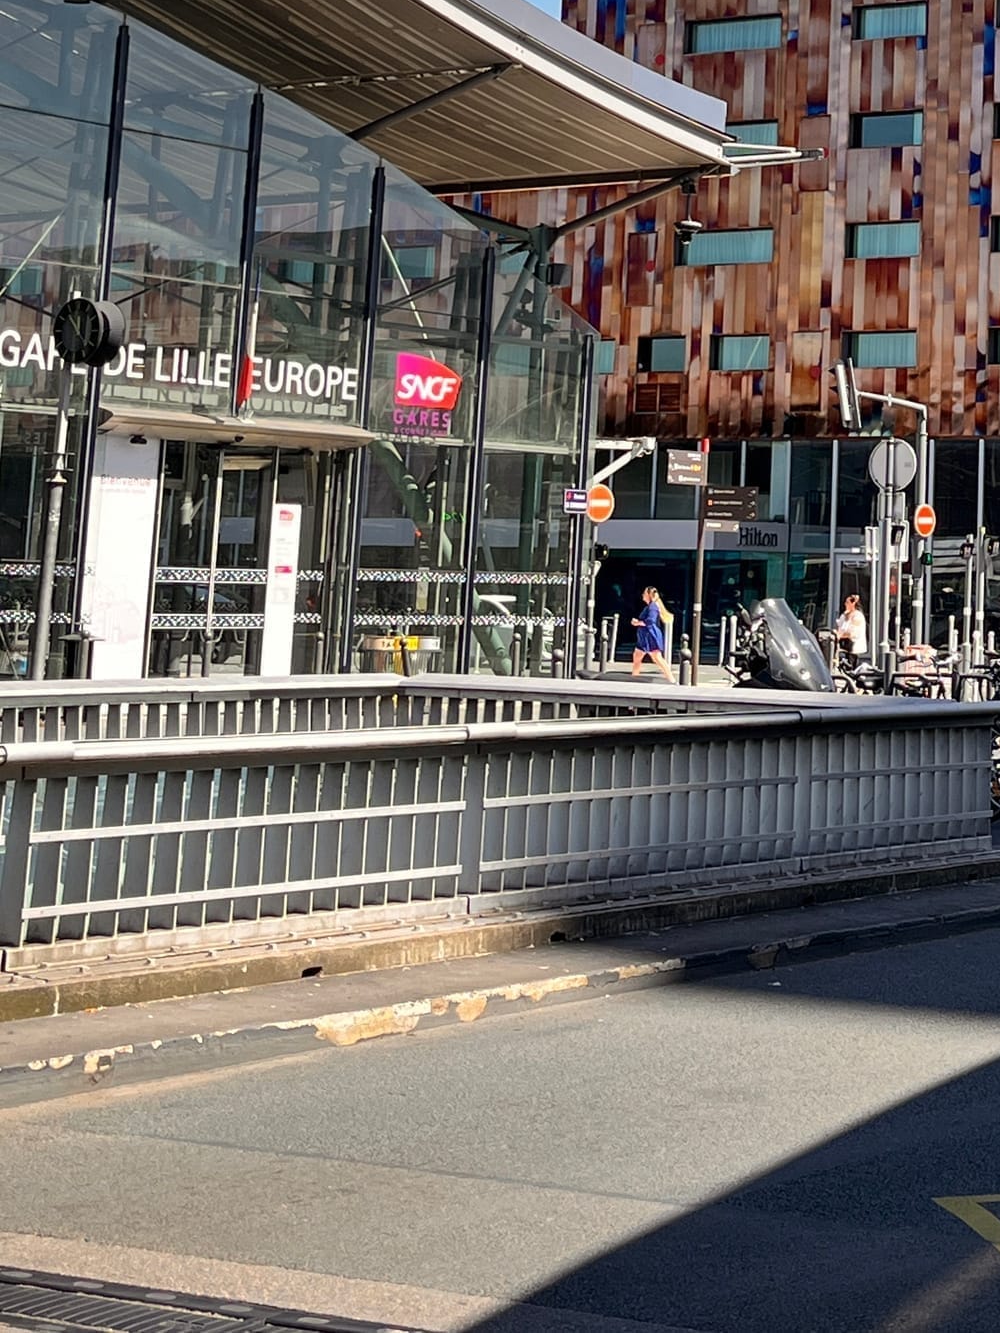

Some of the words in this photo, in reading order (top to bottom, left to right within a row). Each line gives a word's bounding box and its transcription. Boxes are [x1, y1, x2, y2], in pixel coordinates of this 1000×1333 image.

[0, 329, 87, 375] GAR
[103, 342, 147, 379] DE
[155, 346, 232, 388] LILLE
[249, 356, 359, 401] EUROPE
[397, 374, 457, 402] SNCF
[393, 409, 450, 428] GARES
[737, 527, 778, 547] Hilton
